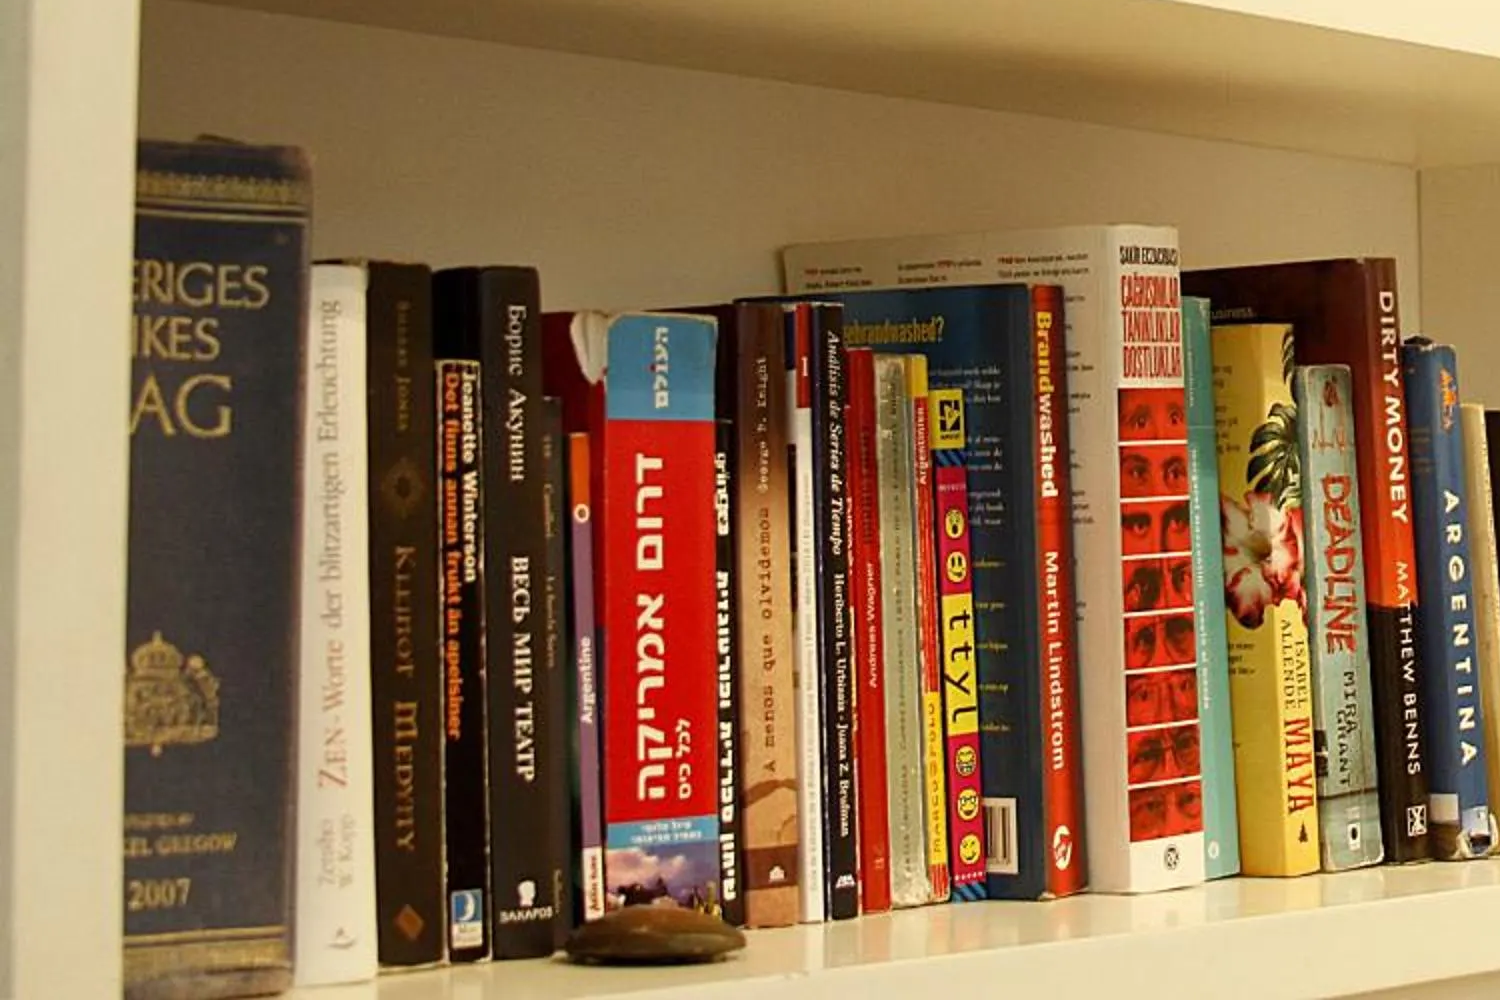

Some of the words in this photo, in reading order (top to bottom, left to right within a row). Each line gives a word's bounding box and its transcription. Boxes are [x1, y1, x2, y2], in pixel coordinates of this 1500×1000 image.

[315, 300, 343, 443] Erleuchtung
[505, 304, 527, 377] Борис
[827, 330, 845, 396] Análisis
[1123, 344, 1182, 378] DOSTLUKLAR
[1378, 290, 1401, 384] DIRTY
[130, 373, 236, 439] AG
[444, 372, 459, 413] Det
[461, 371, 478, 463] Jeanette
[829, 399, 845, 419] de
[1034, 311, 1059, 499] Brandwashed
[445, 419, 460, 473] finns
[506, 387, 527, 482] Акунин
[830, 423, 846, 470] Series
[914, 406, 929, 485] Argentinien
[1383, 395, 1408, 523] MONEY
[318, 452, 346, 581] blitzartigen
[444, 479, 460, 545] annan
[635, 453, 665, 571] דרום
[831, 473, 846, 493] de
[463, 470, 479, 583] Winterson
[828, 497, 847, 555] Tiempo
[445, 550, 463, 604] frukt
[510, 555, 531, 623] ВЕСЬ
[757, 507, 774, 621] olvidemos
[862, 561, 876, 621] Wagner
[1046, 551, 1062, 633] Martin
[1320, 474, 1359, 655] DEADLINE
[319, 589, 344, 630] der
[447, 607, 462, 634] än
[833, 572, 847, 639] Heriberto
[1395, 559, 1417, 681] MATTHEW
[1443, 488, 1478, 766] ARGENTINA
[445, 639, 465, 741] apelsiner
[512, 632, 533, 694] МИР
[577, 636, 597, 725] Argentine
[762, 636, 778, 673] que
[945, 609, 977, 723] ttyl
[1281, 618, 1298, 711] ALLENDE
[1294, 639, 1309, 709] ISABEL
[635, 592, 674, 801] אמריקה
[762, 685, 776, 748] menos
[1049, 641, 1066, 770] Lindstrom
[1342, 670, 1358, 736] MIRA
[1403, 691, 1422, 774] BENNS
[514, 701, 535, 782] ТЕАТР
[675, 718, 693, 758] לכל
[835, 723, 851, 759] Juana
[1283, 716, 1316, 815] MAYA
[1336, 708, 1352, 788] GRANT
[676, 763, 692, 800] כיס
[929, 781, 942, 853] MARCO
[127, 876, 192, 913] 2007
